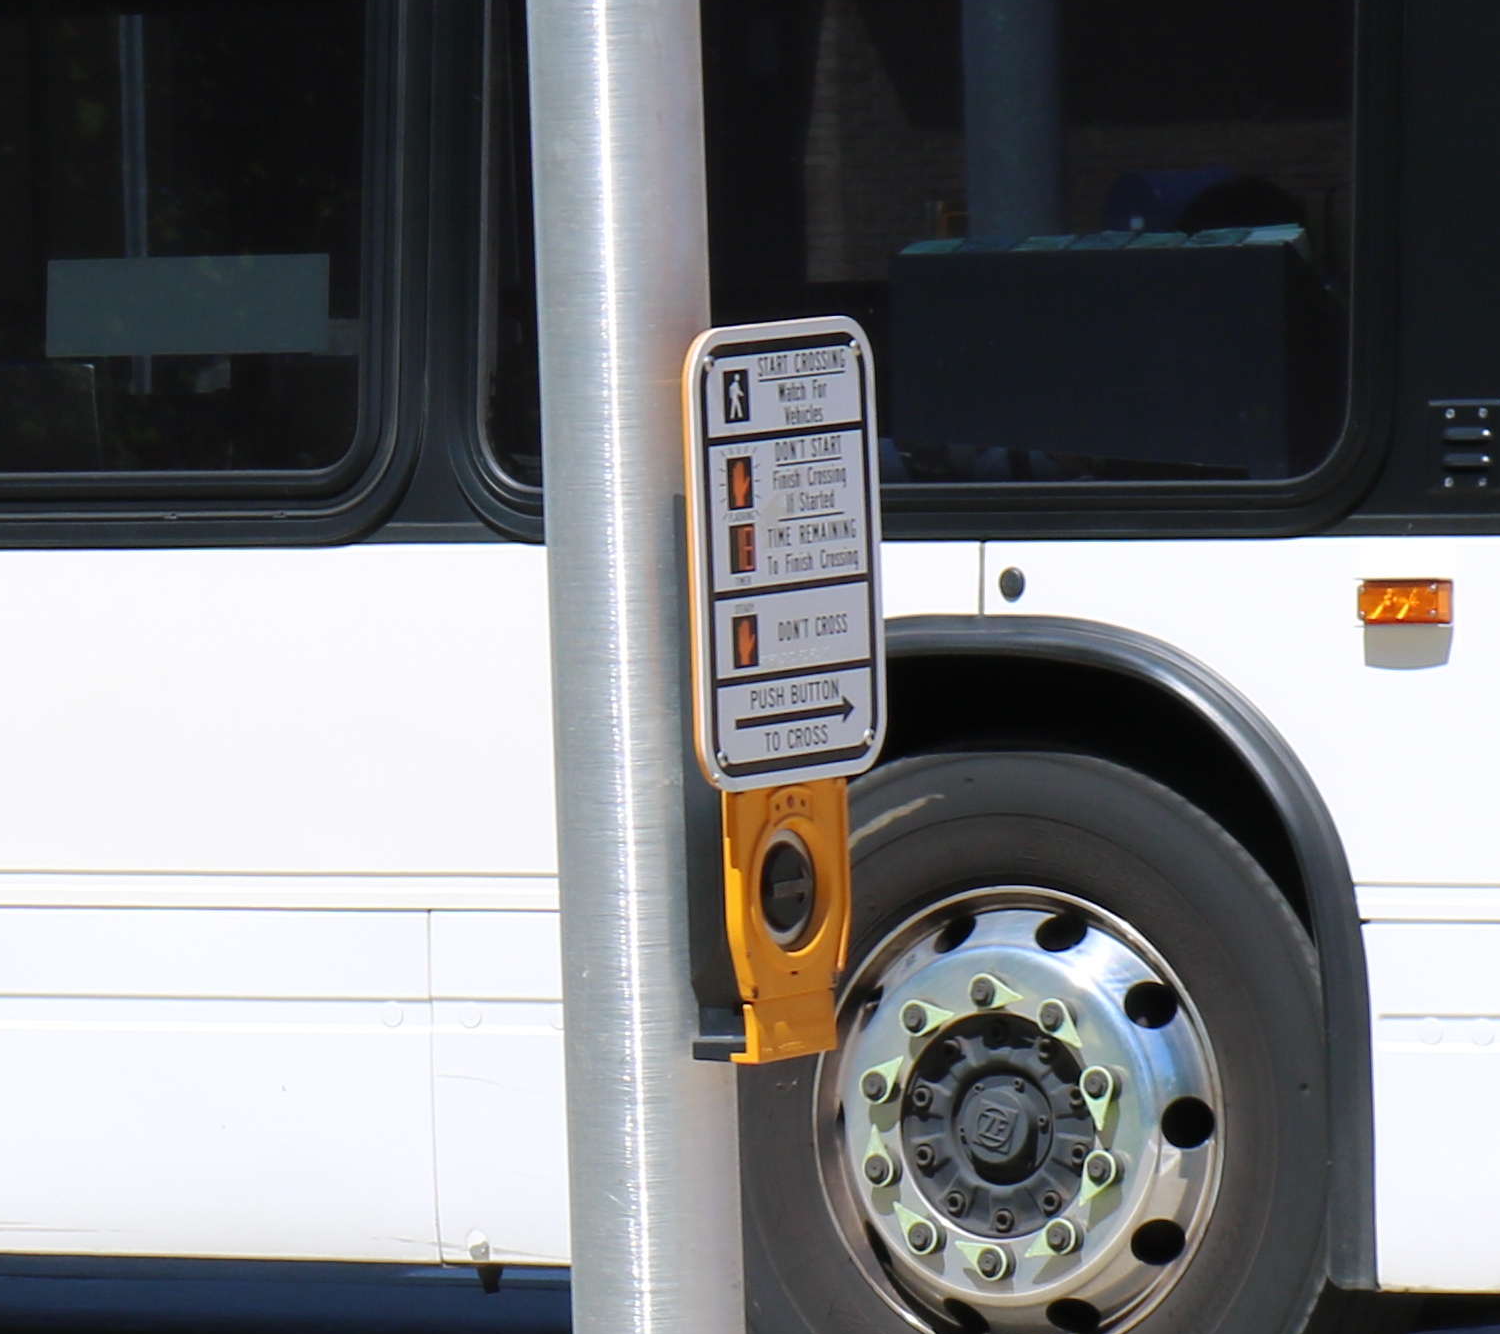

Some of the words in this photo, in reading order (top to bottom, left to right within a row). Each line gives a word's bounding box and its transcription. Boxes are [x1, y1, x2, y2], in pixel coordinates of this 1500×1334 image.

[757, 354, 788, 377] START
[794, 348, 846, 373] CROSSING
[778, 381, 806, 403] Watch
[812, 378, 827, 399] For
[783, 404, 825, 426] Vehicles
[811, 434, 842, 458] START
[772, 467, 800, 491] Finish
[807, 463, 847, 488] Crossing
[799, 487, 835, 512] Started
[766, 525, 792, 549] TIME
[799, 517, 857, 546] REMAINING
[766, 554, 779, 576] To
[785, 549, 815, 574] Finish
[820, 545, 859, 571] Crossing
[815, 612, 848, 637] CROSS
[750, 686, 785, 709] PUSH
[790, 678, 840, 705] BUTTON
[764, 731, 780, 752] TO
[787, 724, 828, 749] CROSS
